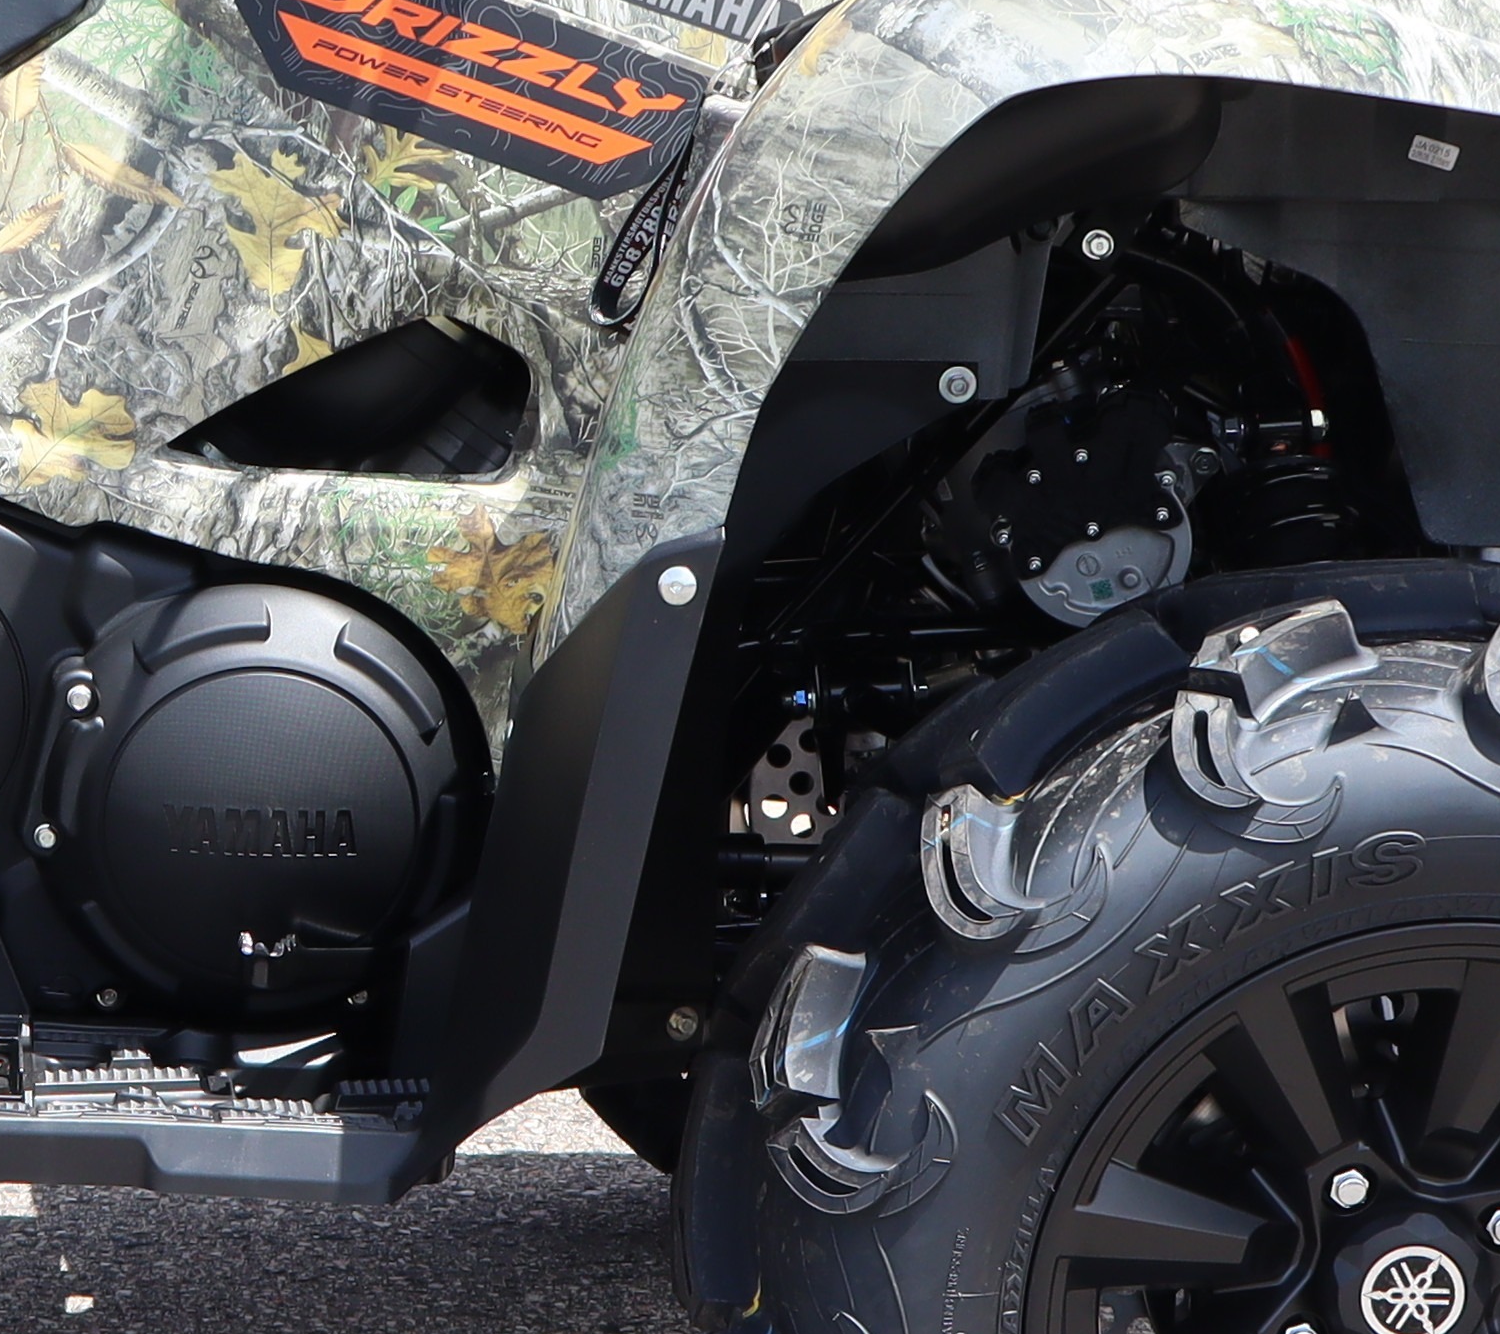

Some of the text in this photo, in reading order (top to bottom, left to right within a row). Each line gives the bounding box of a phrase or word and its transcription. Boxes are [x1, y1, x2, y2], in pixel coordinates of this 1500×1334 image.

[310, 38, 604, 151] POWER STEERING
[162, 803, 358, 859] YAMAHA
[993, 830, 1427, 1147] MAXXIS
